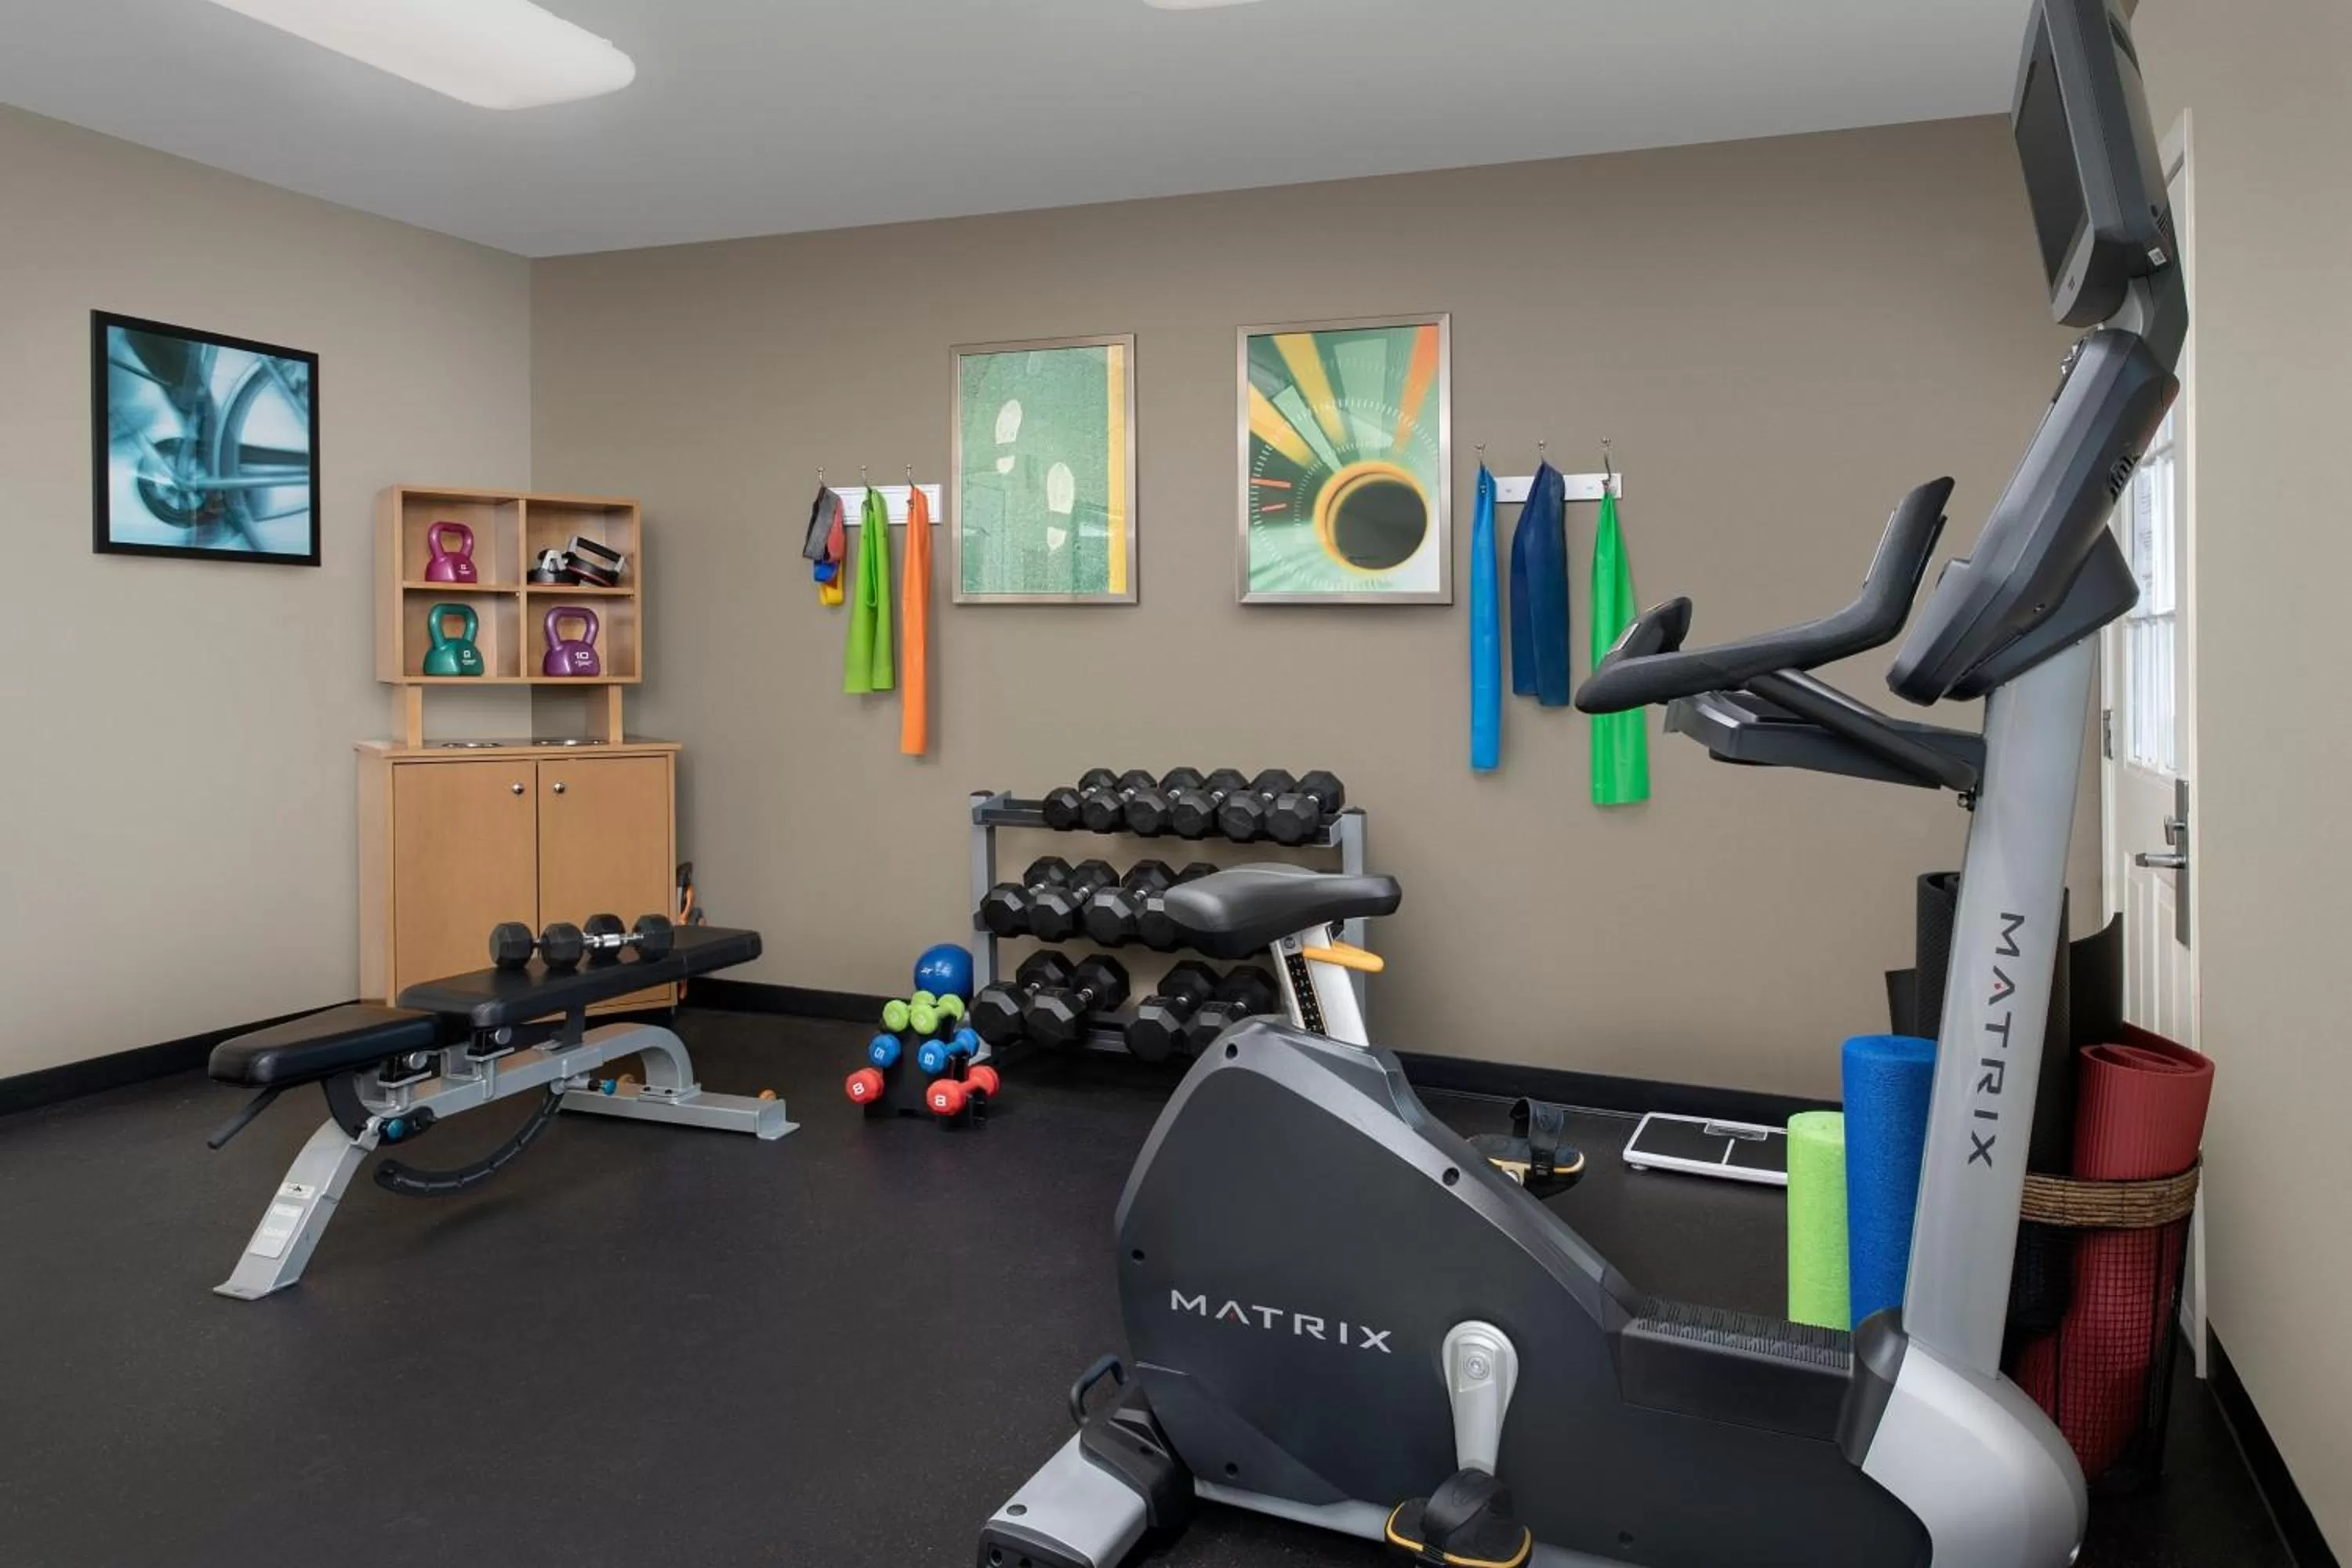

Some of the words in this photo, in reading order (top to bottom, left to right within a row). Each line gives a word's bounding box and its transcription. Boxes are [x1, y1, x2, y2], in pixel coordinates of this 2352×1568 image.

[1968, 912, 2025, 1167] MATRIX
[935, 1094, 946, 1106] 8
[1171, 1290, 1392, 1353] MATRIX
